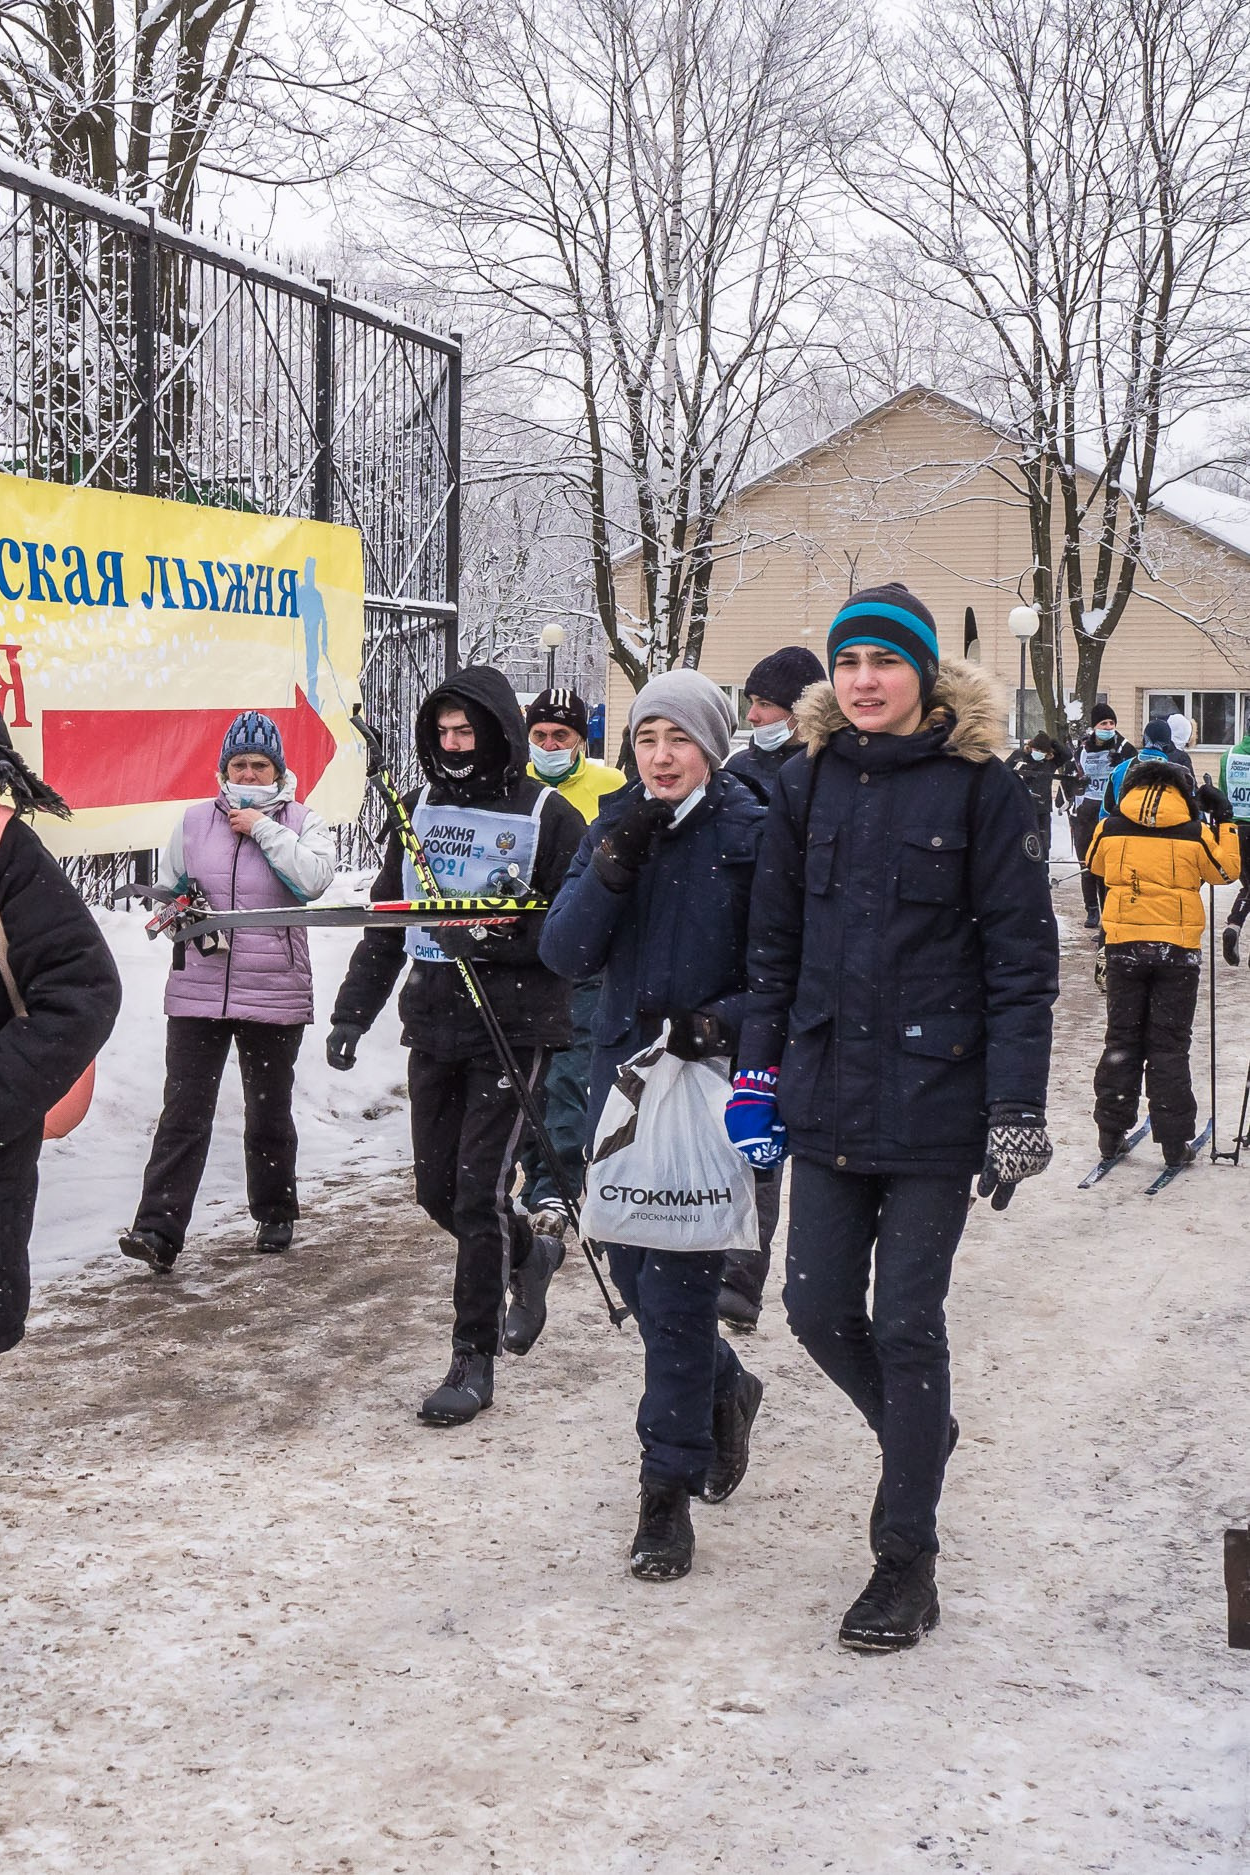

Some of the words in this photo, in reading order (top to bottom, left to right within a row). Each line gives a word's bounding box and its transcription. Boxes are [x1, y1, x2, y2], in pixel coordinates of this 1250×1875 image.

[425, 825, 475, 842] ЛЫЖНЯ
[422, 839, 471, 857] РОССИИ
[429, 857, 466, 877] 021
[600, 1185, 732, 1206] СТОКМАНН
